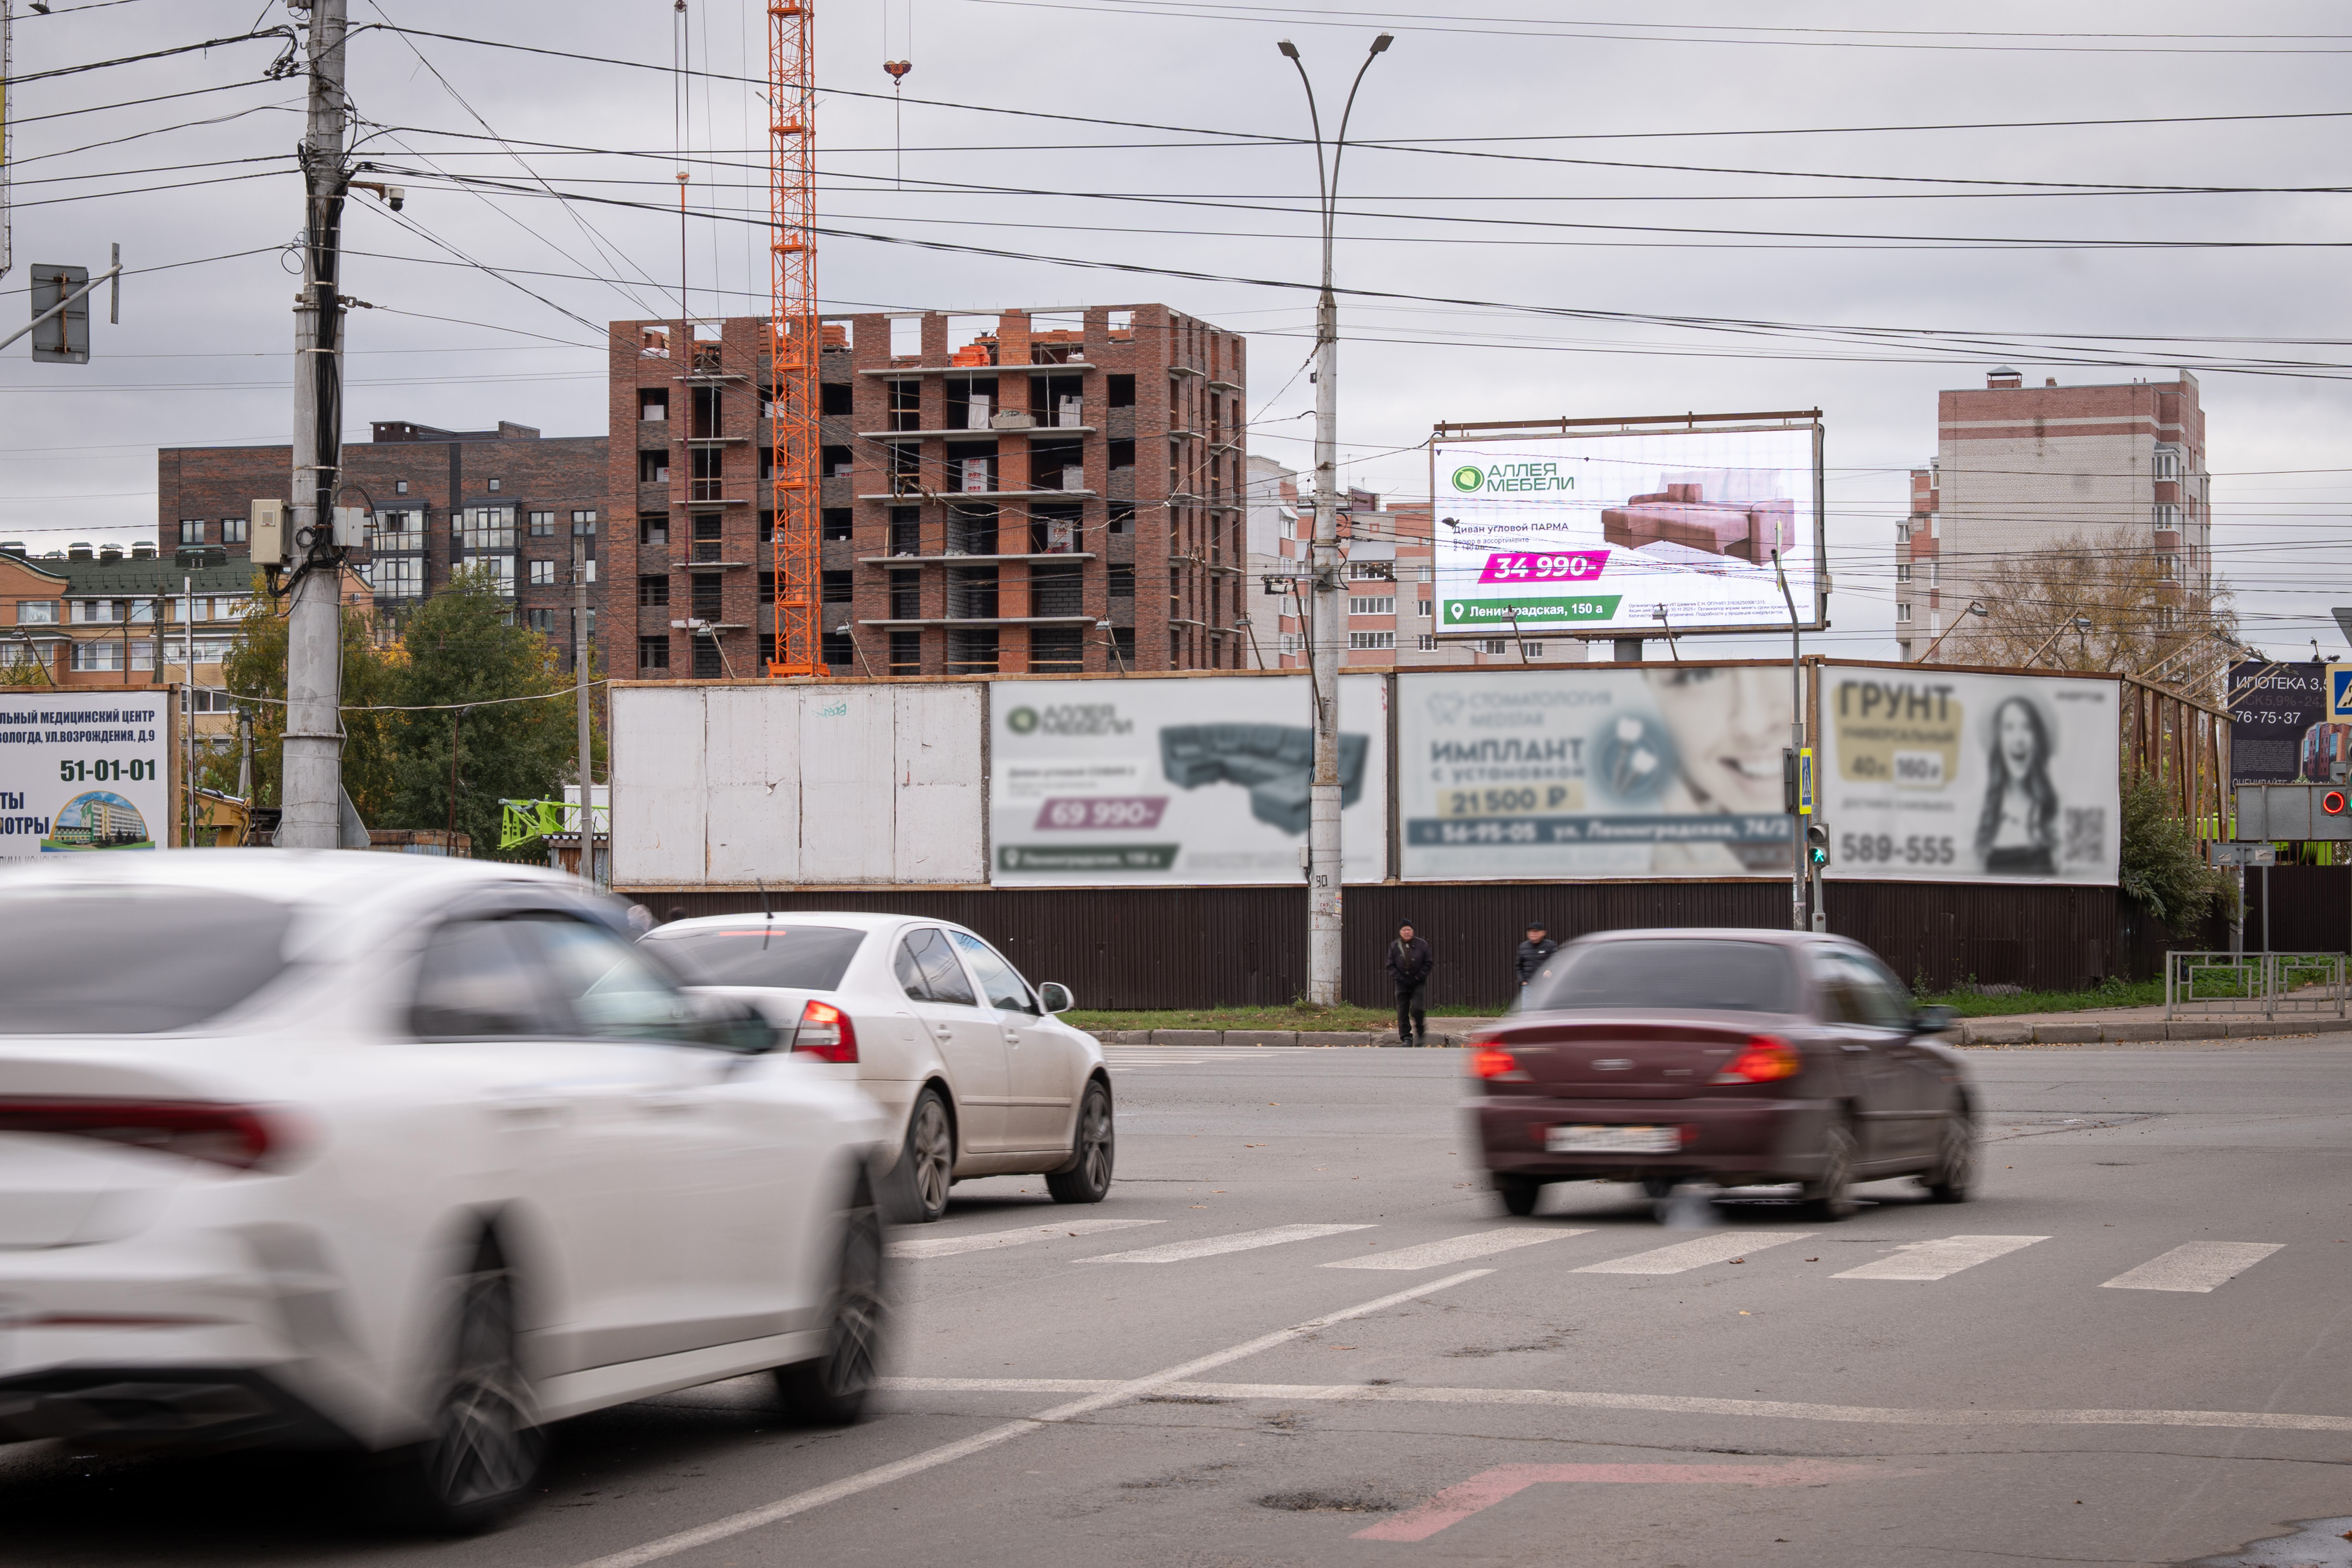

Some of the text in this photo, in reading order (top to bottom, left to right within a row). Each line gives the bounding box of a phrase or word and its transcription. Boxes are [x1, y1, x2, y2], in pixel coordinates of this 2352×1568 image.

[1488, 462, 1556, 477] АЛЛЕЯ
[1487, 477, 1574, 492] МЕБЕЛИ
[1453, 525, 1485, 534] Диван
[1488, 523, 1528, 533] угловой
[1494, 557, 1529, 579] 34
[1572, 603, 1593, 614] 150
[1595, 605, 1603, 614] а
[2236, 676, 2307, 689] ИПОТЕКА
[1840, 680, 1954, 721] ГРУНТ
[40, 708, 119, 725] МЕДИЦИНСКИЙ
[122, 710, 155, 724] ЦЕНТР
[45, 730, 136, 743] УЛ.ВОЗРОЖДЕНИЯ,
[138, 729, 155, 743] Д.9
[1431, 738, 1584, 763] ИМПЛАНТ
[60, 759, 155, 782] 51-01-01
[0, 817, 49, 835] ОТРЫ
[1842, 833, 1955, 865] 589-555
[1316, 875, 1327, 888] 90
